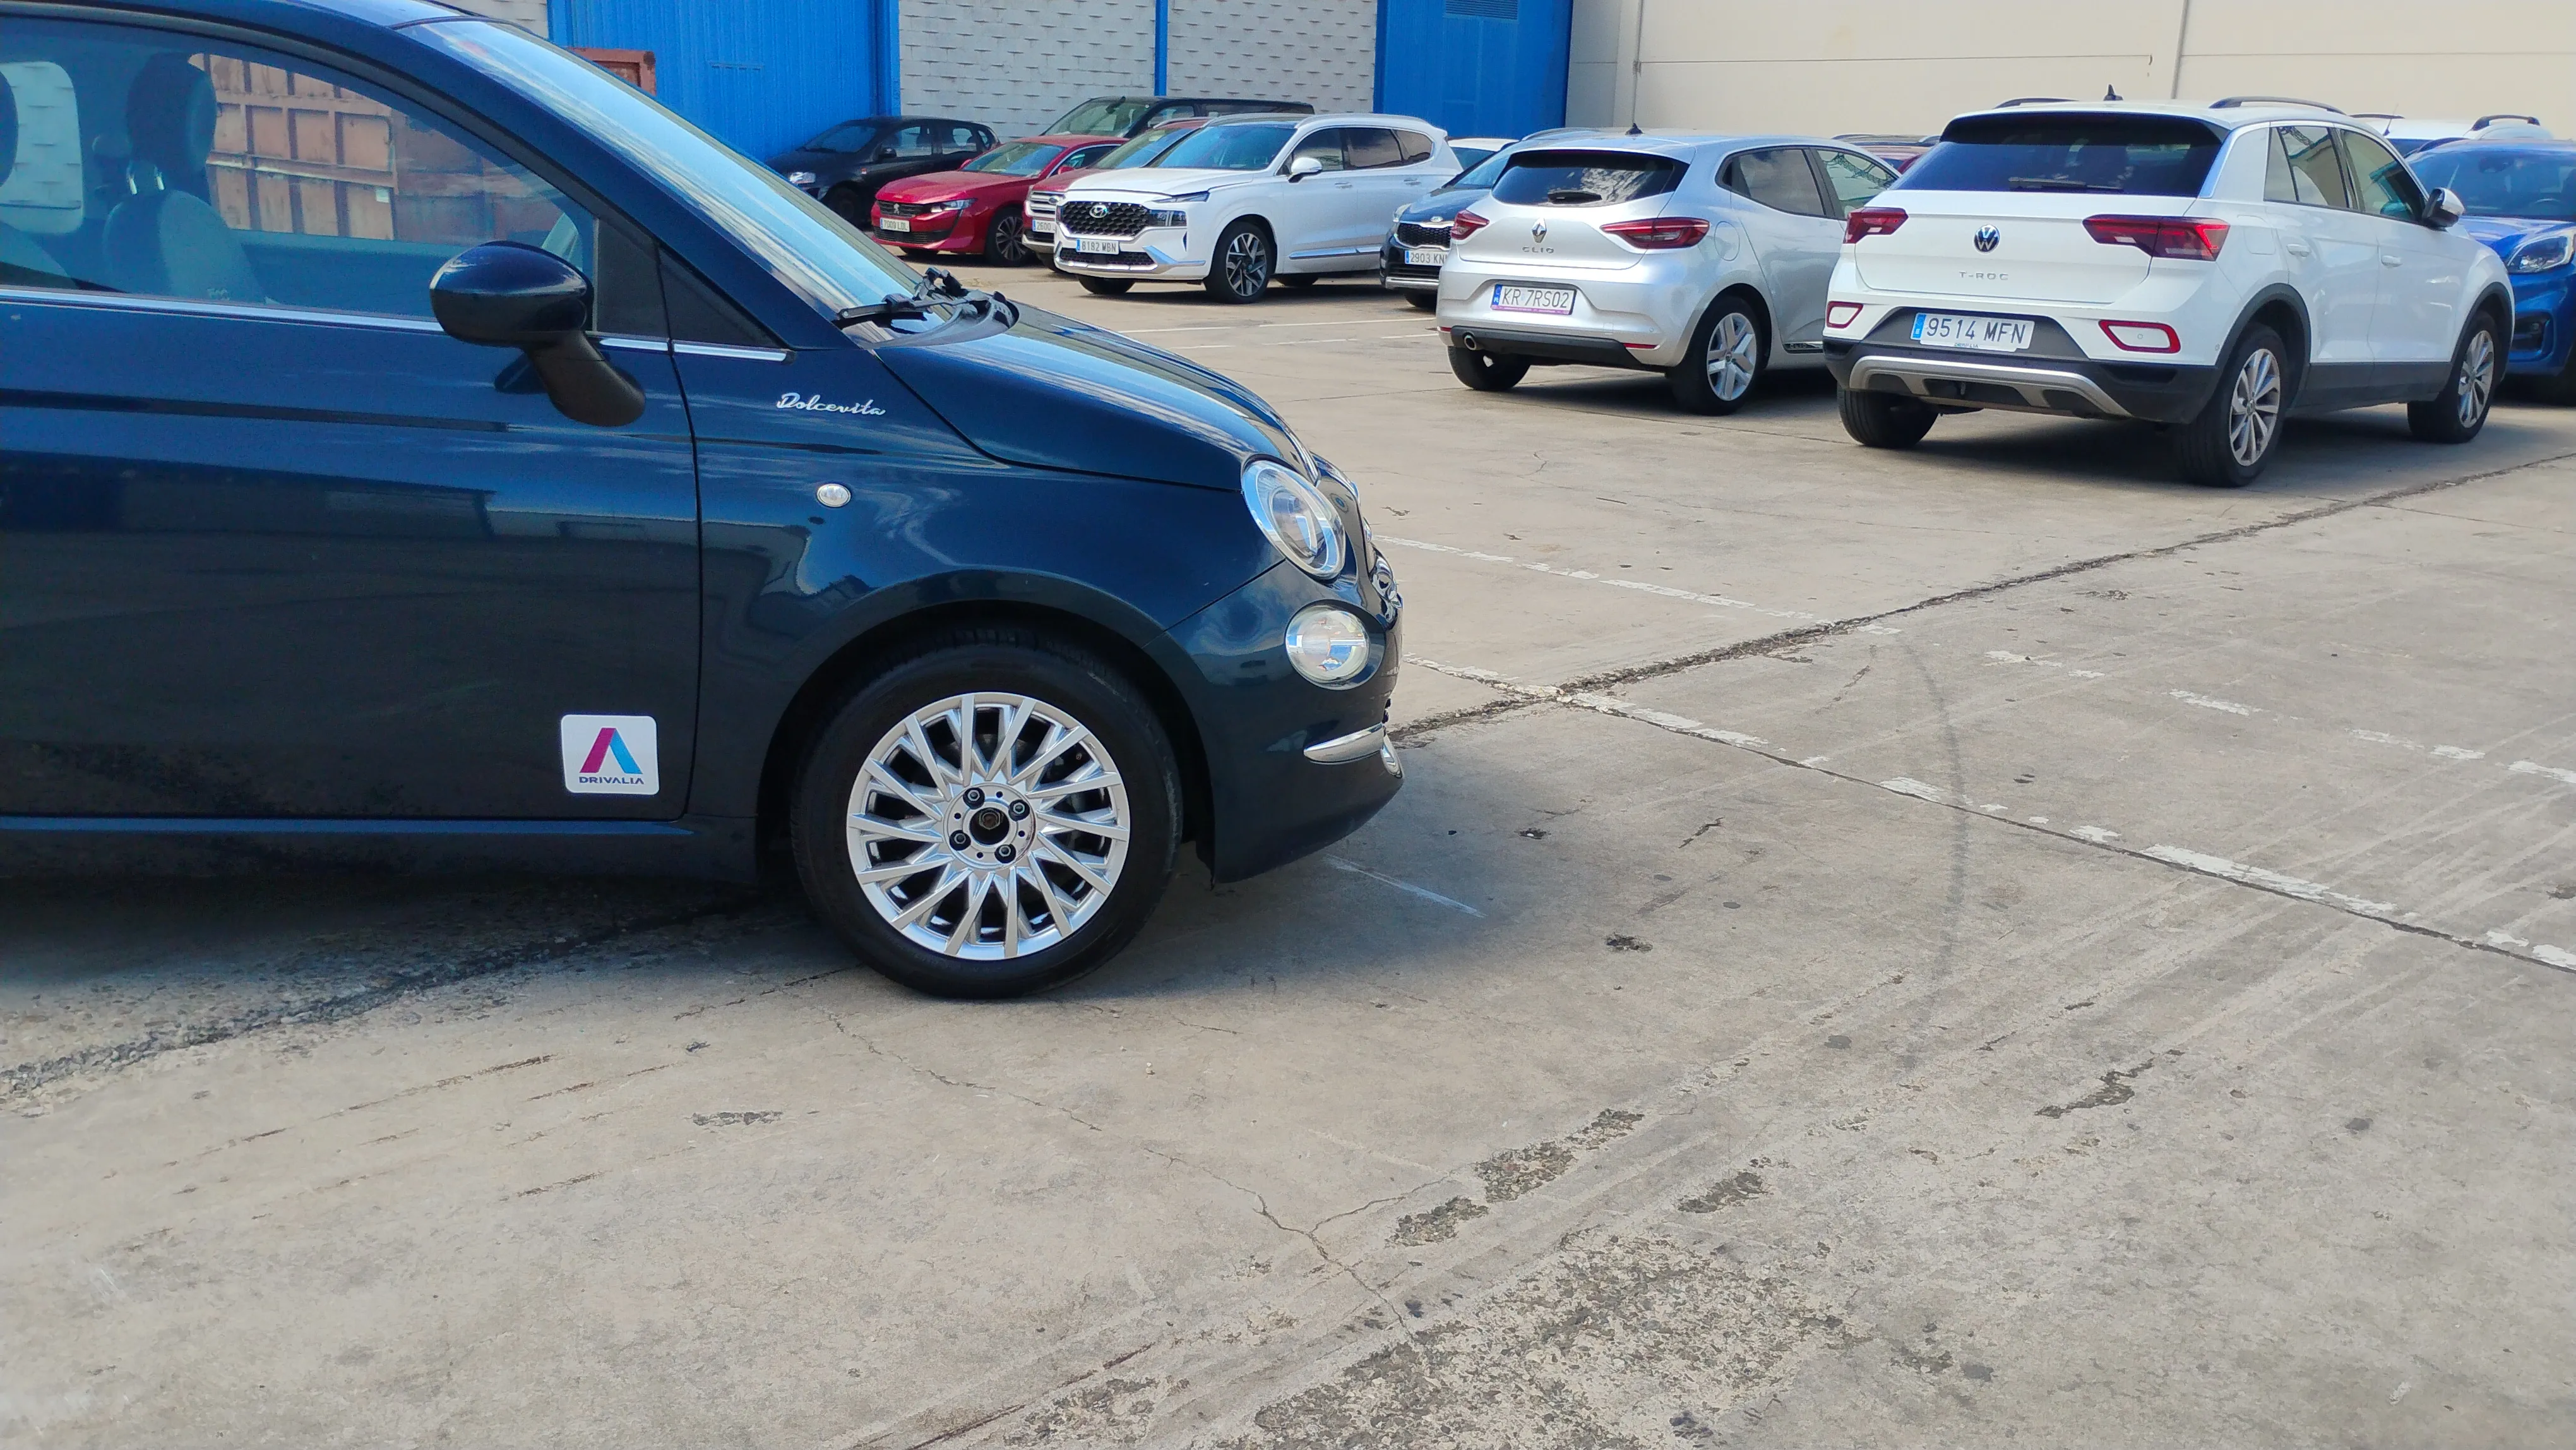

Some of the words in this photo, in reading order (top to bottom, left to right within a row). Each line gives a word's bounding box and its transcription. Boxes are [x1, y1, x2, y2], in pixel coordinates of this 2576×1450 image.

[1410, 253, 1431, 263] 2903
[1434, 254, 1447, 263] KN
[1959, 271, 2008, 280] T-ROC
[1502, 288, 1521, 305] KR
[1525, 289, 1570, 308] 7RS02
[1927, 318, 1976, 340] 9514
[1984, 321, 2025, 344] MFN
[777, 392, 886, 416] Dolcevita
[579, 776, 645, 784] DRIVALIA
